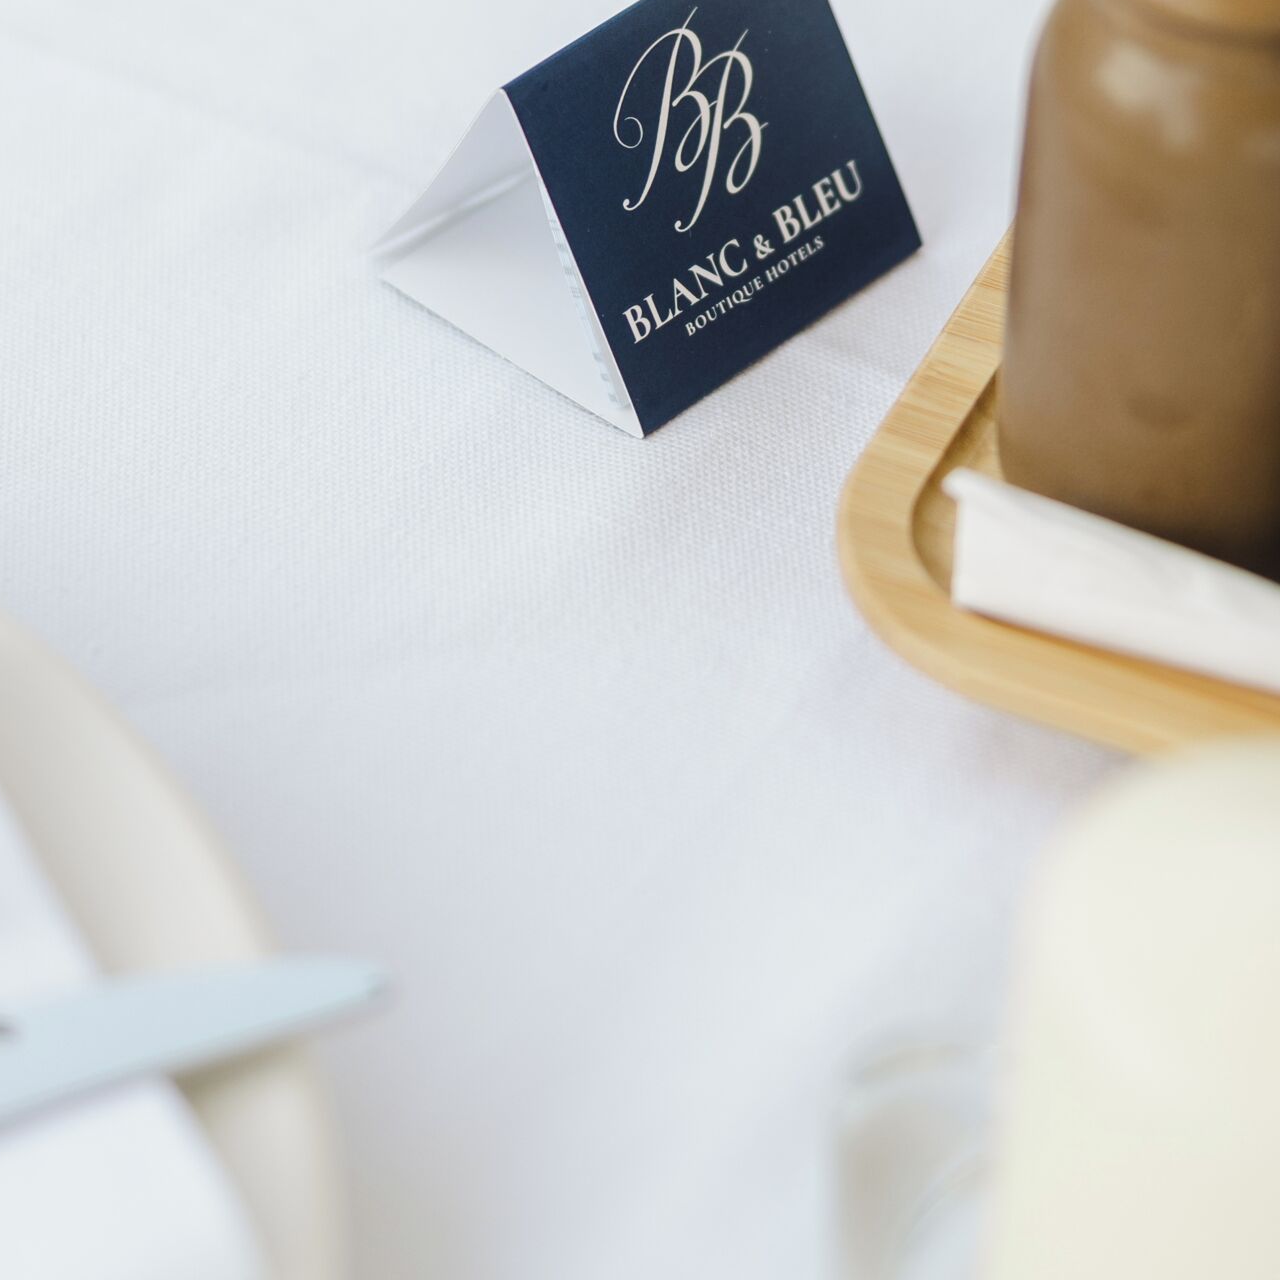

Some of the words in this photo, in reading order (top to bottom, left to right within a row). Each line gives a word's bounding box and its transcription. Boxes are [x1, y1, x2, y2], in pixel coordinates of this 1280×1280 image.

[622, 239, 748, 344] BLANC
[753, 234, 775, 260] &
[772, 160, 863, 244] BLEU
[685, 276, 764, 337] BOUTIQUE
[765, 235, 825, 283] HOTELS
